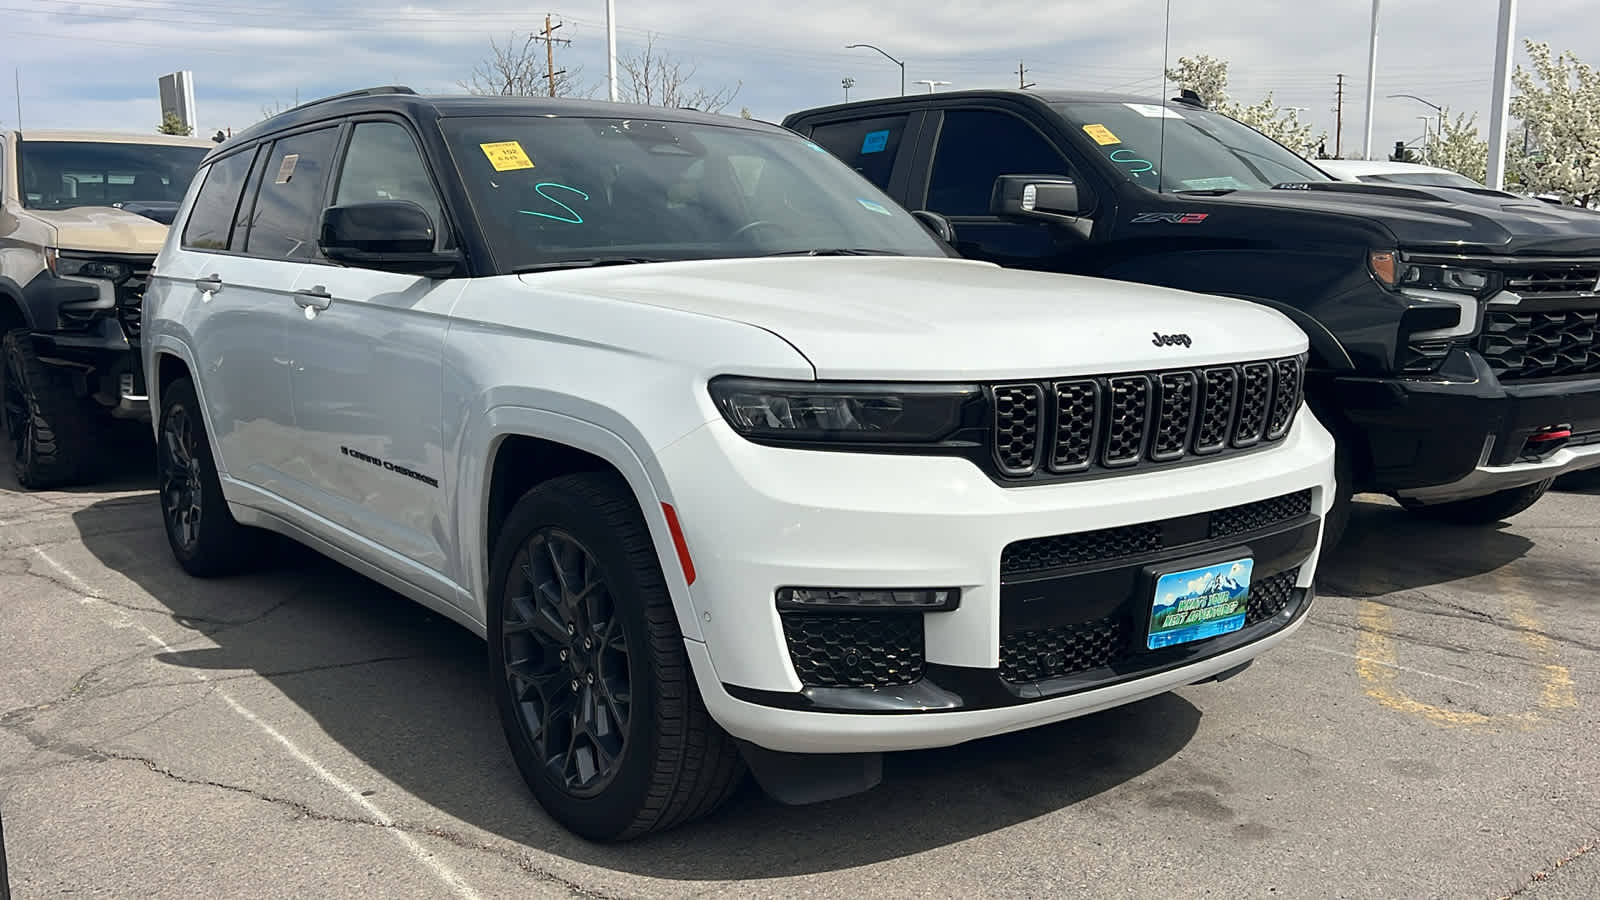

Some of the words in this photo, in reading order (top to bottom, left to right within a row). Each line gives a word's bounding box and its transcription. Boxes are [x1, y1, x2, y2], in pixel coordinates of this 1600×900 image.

[1130, 212, 1208, 223] ZR2
[1151, 331, 1192, 349] Jeep
[349, 449, 382, 467] GRAND
[383, 461, 439, 488] CHEROKEE
[1207, 591, 1230, 608] YOUR
[1162, 612, 1189, 628] NEXT
